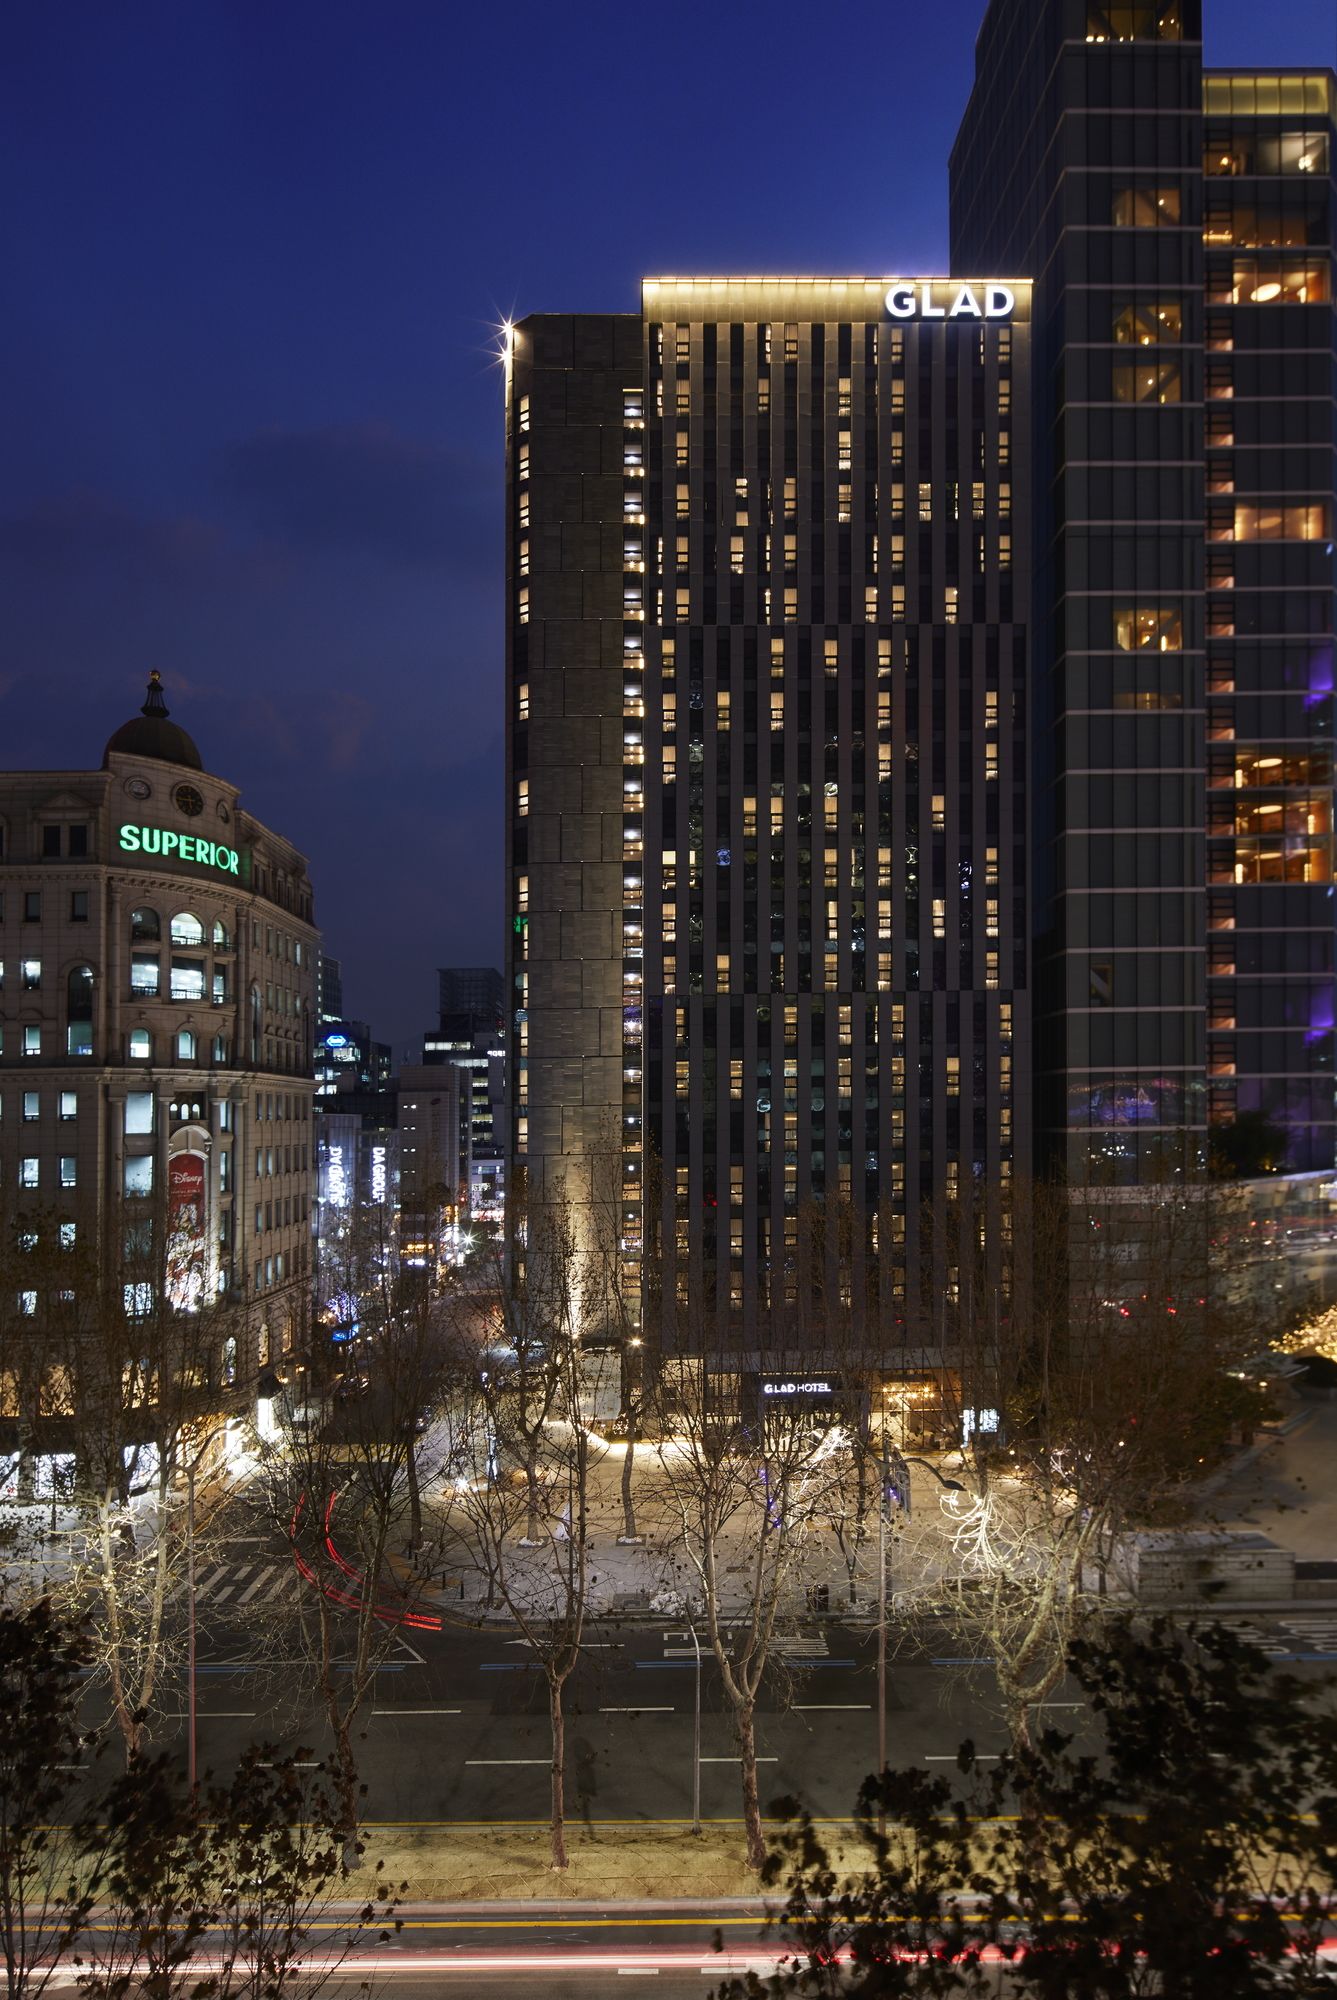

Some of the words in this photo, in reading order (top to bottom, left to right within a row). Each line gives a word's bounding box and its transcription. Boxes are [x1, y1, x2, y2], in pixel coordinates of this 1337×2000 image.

[885, 284, 1015, 317] GLAD
[119, 824, 239, 875] SUPERIOR
[170, 1171, 203, 1186] Disney
[764, 1383, 796, 1394] GLAD
[797, 1382, 832, 1393] HOTEL
